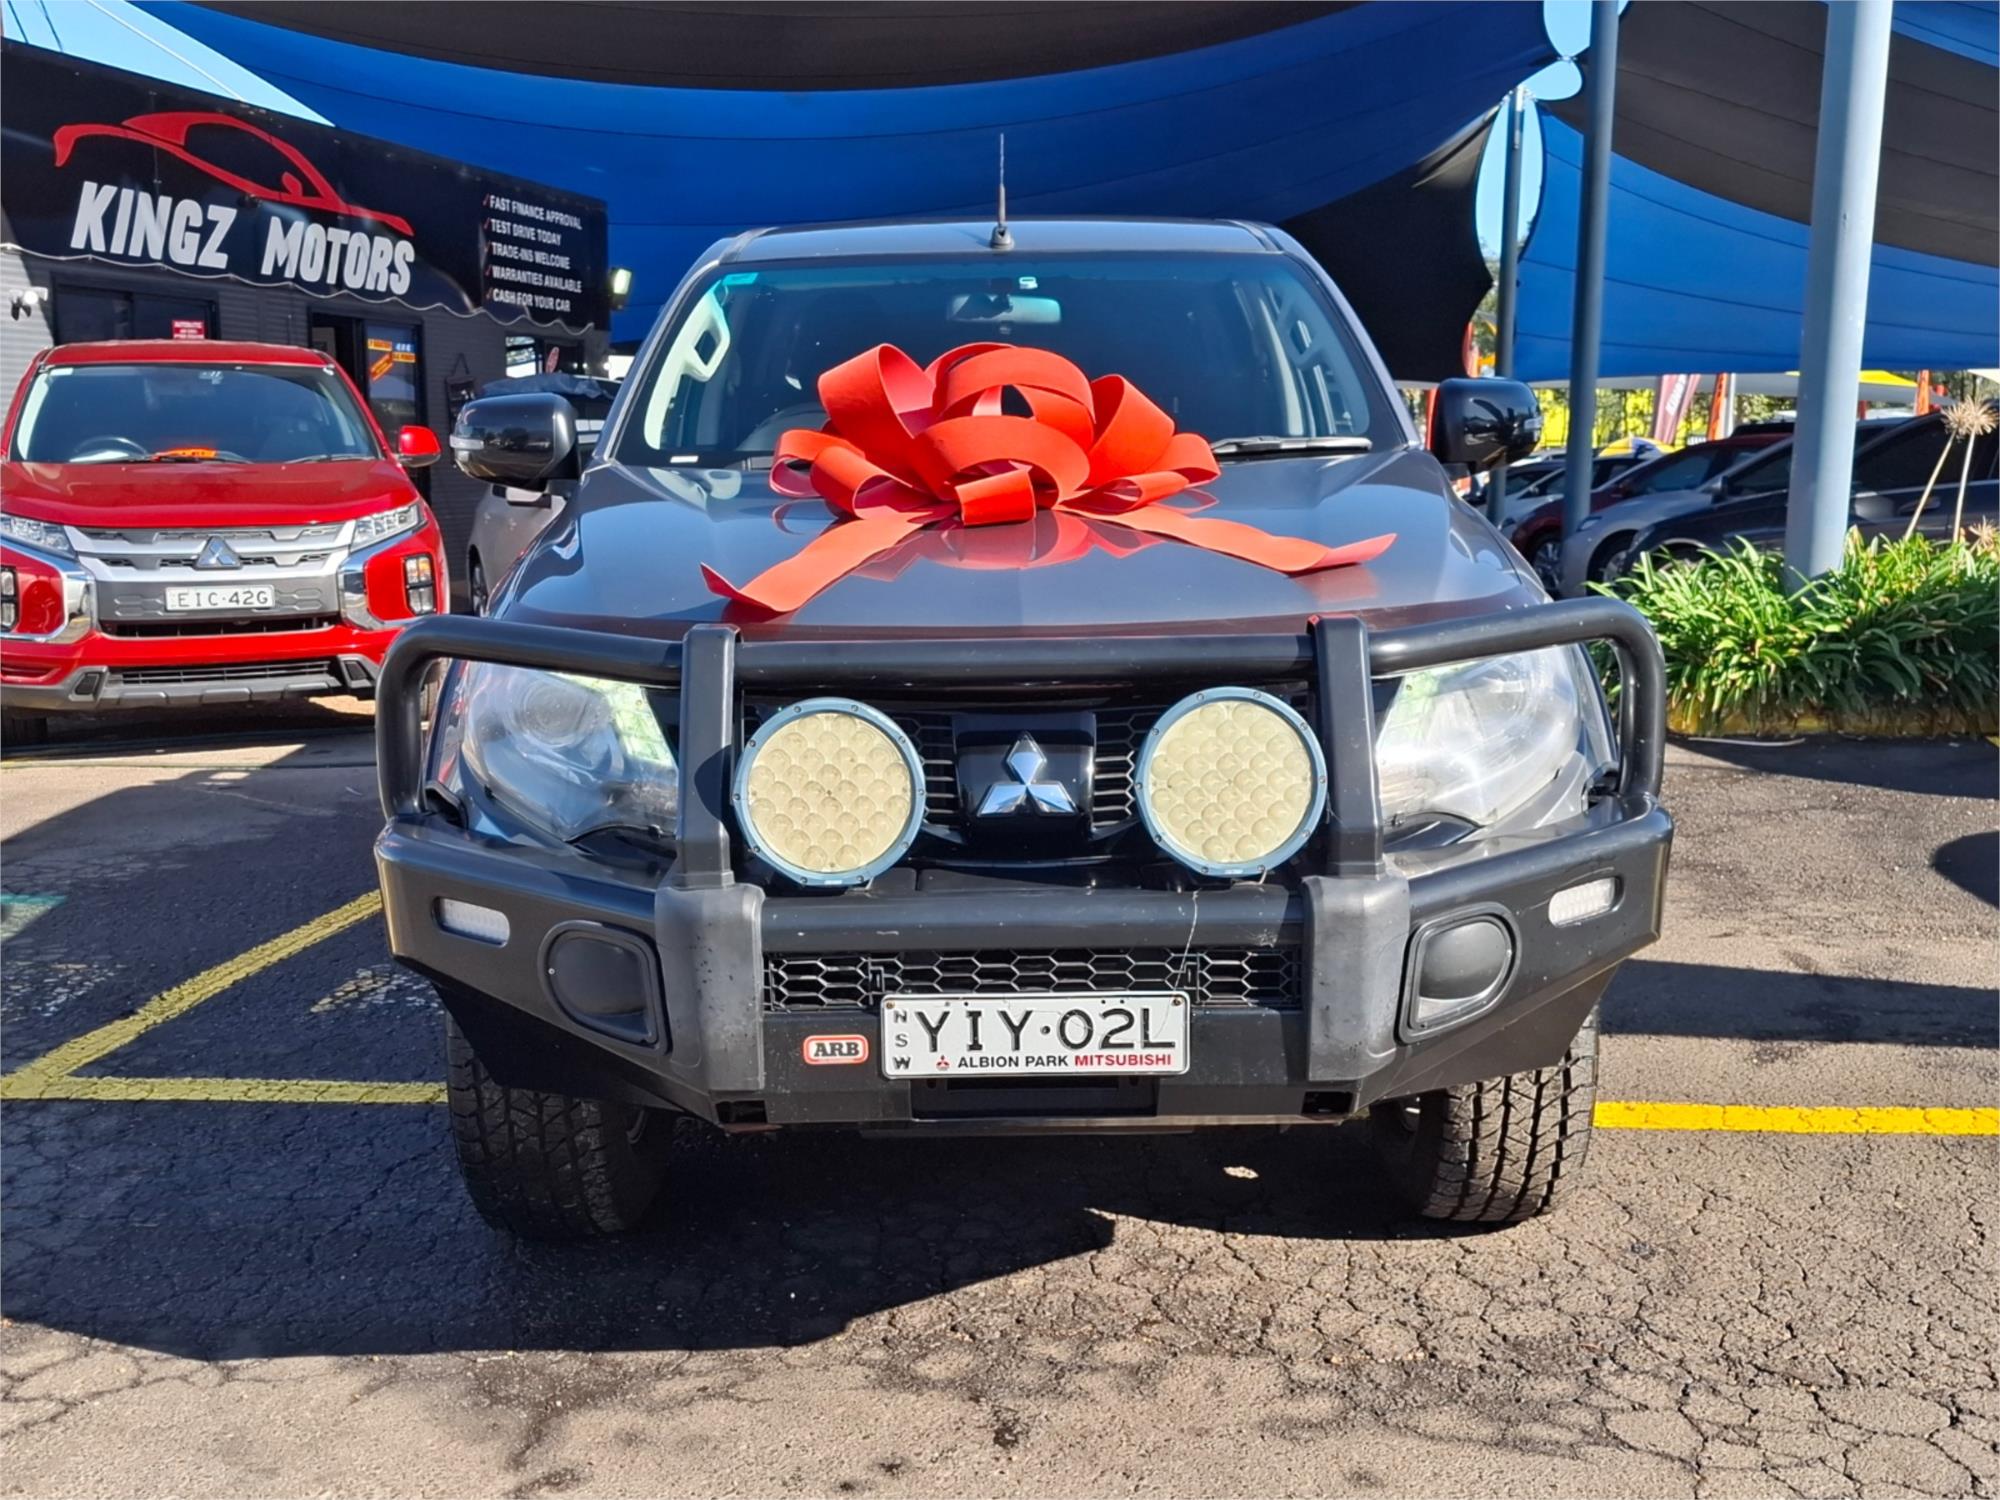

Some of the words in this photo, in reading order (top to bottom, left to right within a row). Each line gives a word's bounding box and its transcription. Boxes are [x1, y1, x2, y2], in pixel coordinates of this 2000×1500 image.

[489, 194, 511, 212] FAST
[511, 201, 545, 221] FINANCE
[545, 209, 583, 230] APPROVAL
[70, 181, 238, 270] KINGZ
[260, 215, 416, 295] MOTORS
[490, 218, 511, 235] TEST
[512, 223, 536, 241] DRIVE
[536, 228, 562, 246] TODAY
[491, 241, 534, 263] TRADE-INS
[534, 250, 571, 270] WELCOME
[491, 265, 543, 287] WARRANTIES
[544, 275, 582, 294] AVAILABLE
[492, 287, 517, 304] CASH
[516, 292, 534, 307] FOR
[534, 294, 555, 310] YOUR
[555, 298, 571, 312] CAR
[813, 1041, 861, 1058] ARB
[957, 1055, 1020, 1069] ALBION
[1024, 1055, 1069, 1068] PARK
[1074, 1053, 1172, 1067] MITSUBISHI
